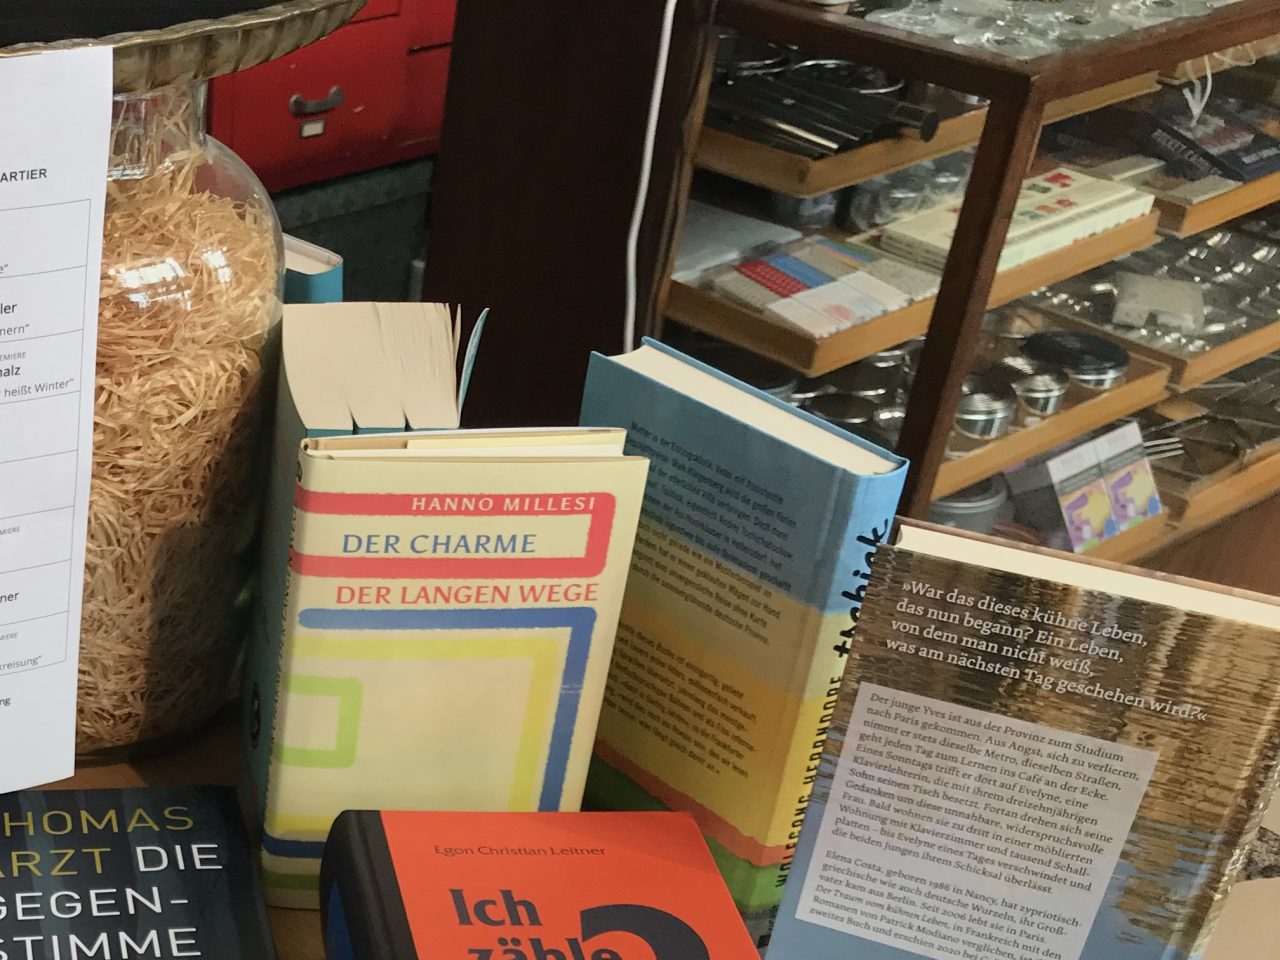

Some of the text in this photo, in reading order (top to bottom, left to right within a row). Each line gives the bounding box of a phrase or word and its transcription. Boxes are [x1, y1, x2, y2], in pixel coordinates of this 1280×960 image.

[411, 496, 596, 512] HANNO MILLESI
[342, 534, 537, 554] DER CHARME
[336, 583, 600, 605] DER LANGEN WEGE
[896, 598, 1125, 663] das nun begann? Ein Leben,
[902, 580, 1148, 647] »War das dieses kühne Leben,
[891, 619, 1095, 677] von dem man nicht weiß,
[886, 638, 1209, 722] was am nächsten Tag geschehen wird?«
[870, 693, 1124, 762] Der junge Yves ist aus der Provinz zum Studium
[135, 844, 223, 872] DIE
[434, 845, 607, 858] Egon Christian Leitner
[448, 889, 543, 927] Ich
